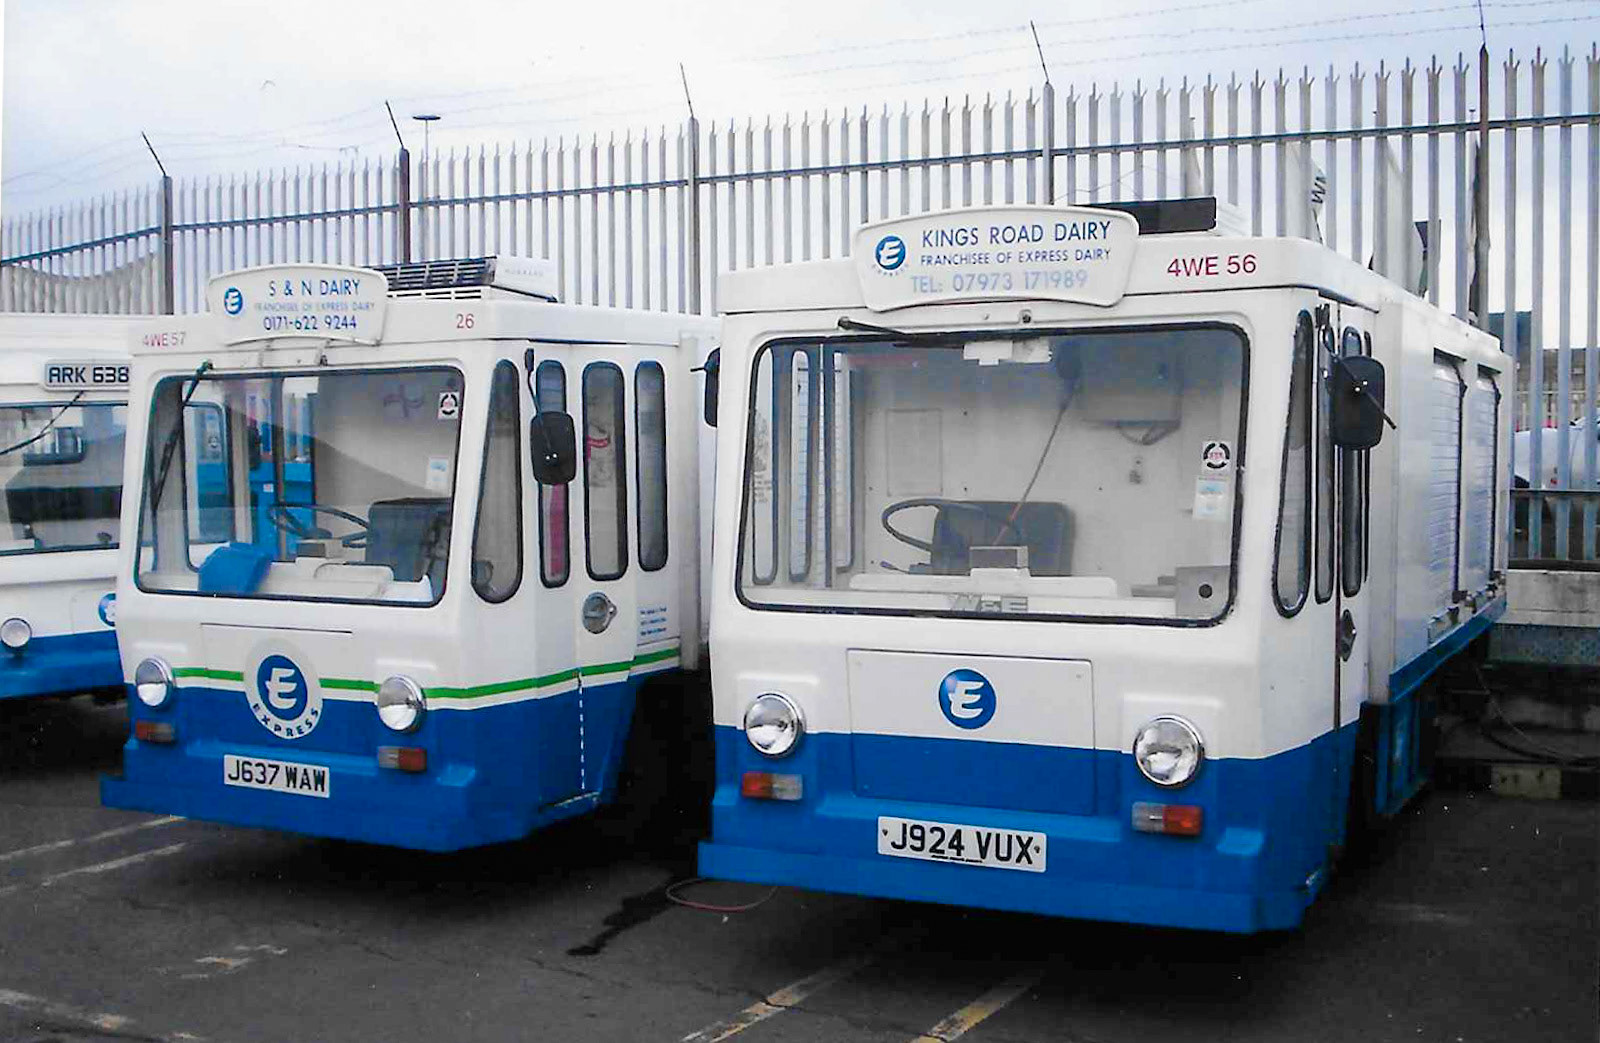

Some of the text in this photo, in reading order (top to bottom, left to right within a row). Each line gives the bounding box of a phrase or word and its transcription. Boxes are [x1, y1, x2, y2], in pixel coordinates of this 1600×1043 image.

[922, 221, 1111, 248] KINGS ROAD DAIRY
[920, 248, 1111, 266] FRANCHISEE OF EXPRESS DAIRY
[1167, 254, 1257, 277] 4WE 56
[269, 279, 361, 296] S & N DAIRY
[910, 269, 1089, 294] TEL: 07973 171989
[263, 315, 357, 331] 0171-622 9244
[456, 313, 475, 329] 26
[49, 366, 130, 383] ARK 638
[252, 702, 319, 737] EXPRESS
[228, 760, 325, 793] J637 WAW
[890, 822, 1034, 865] J924 VUX
